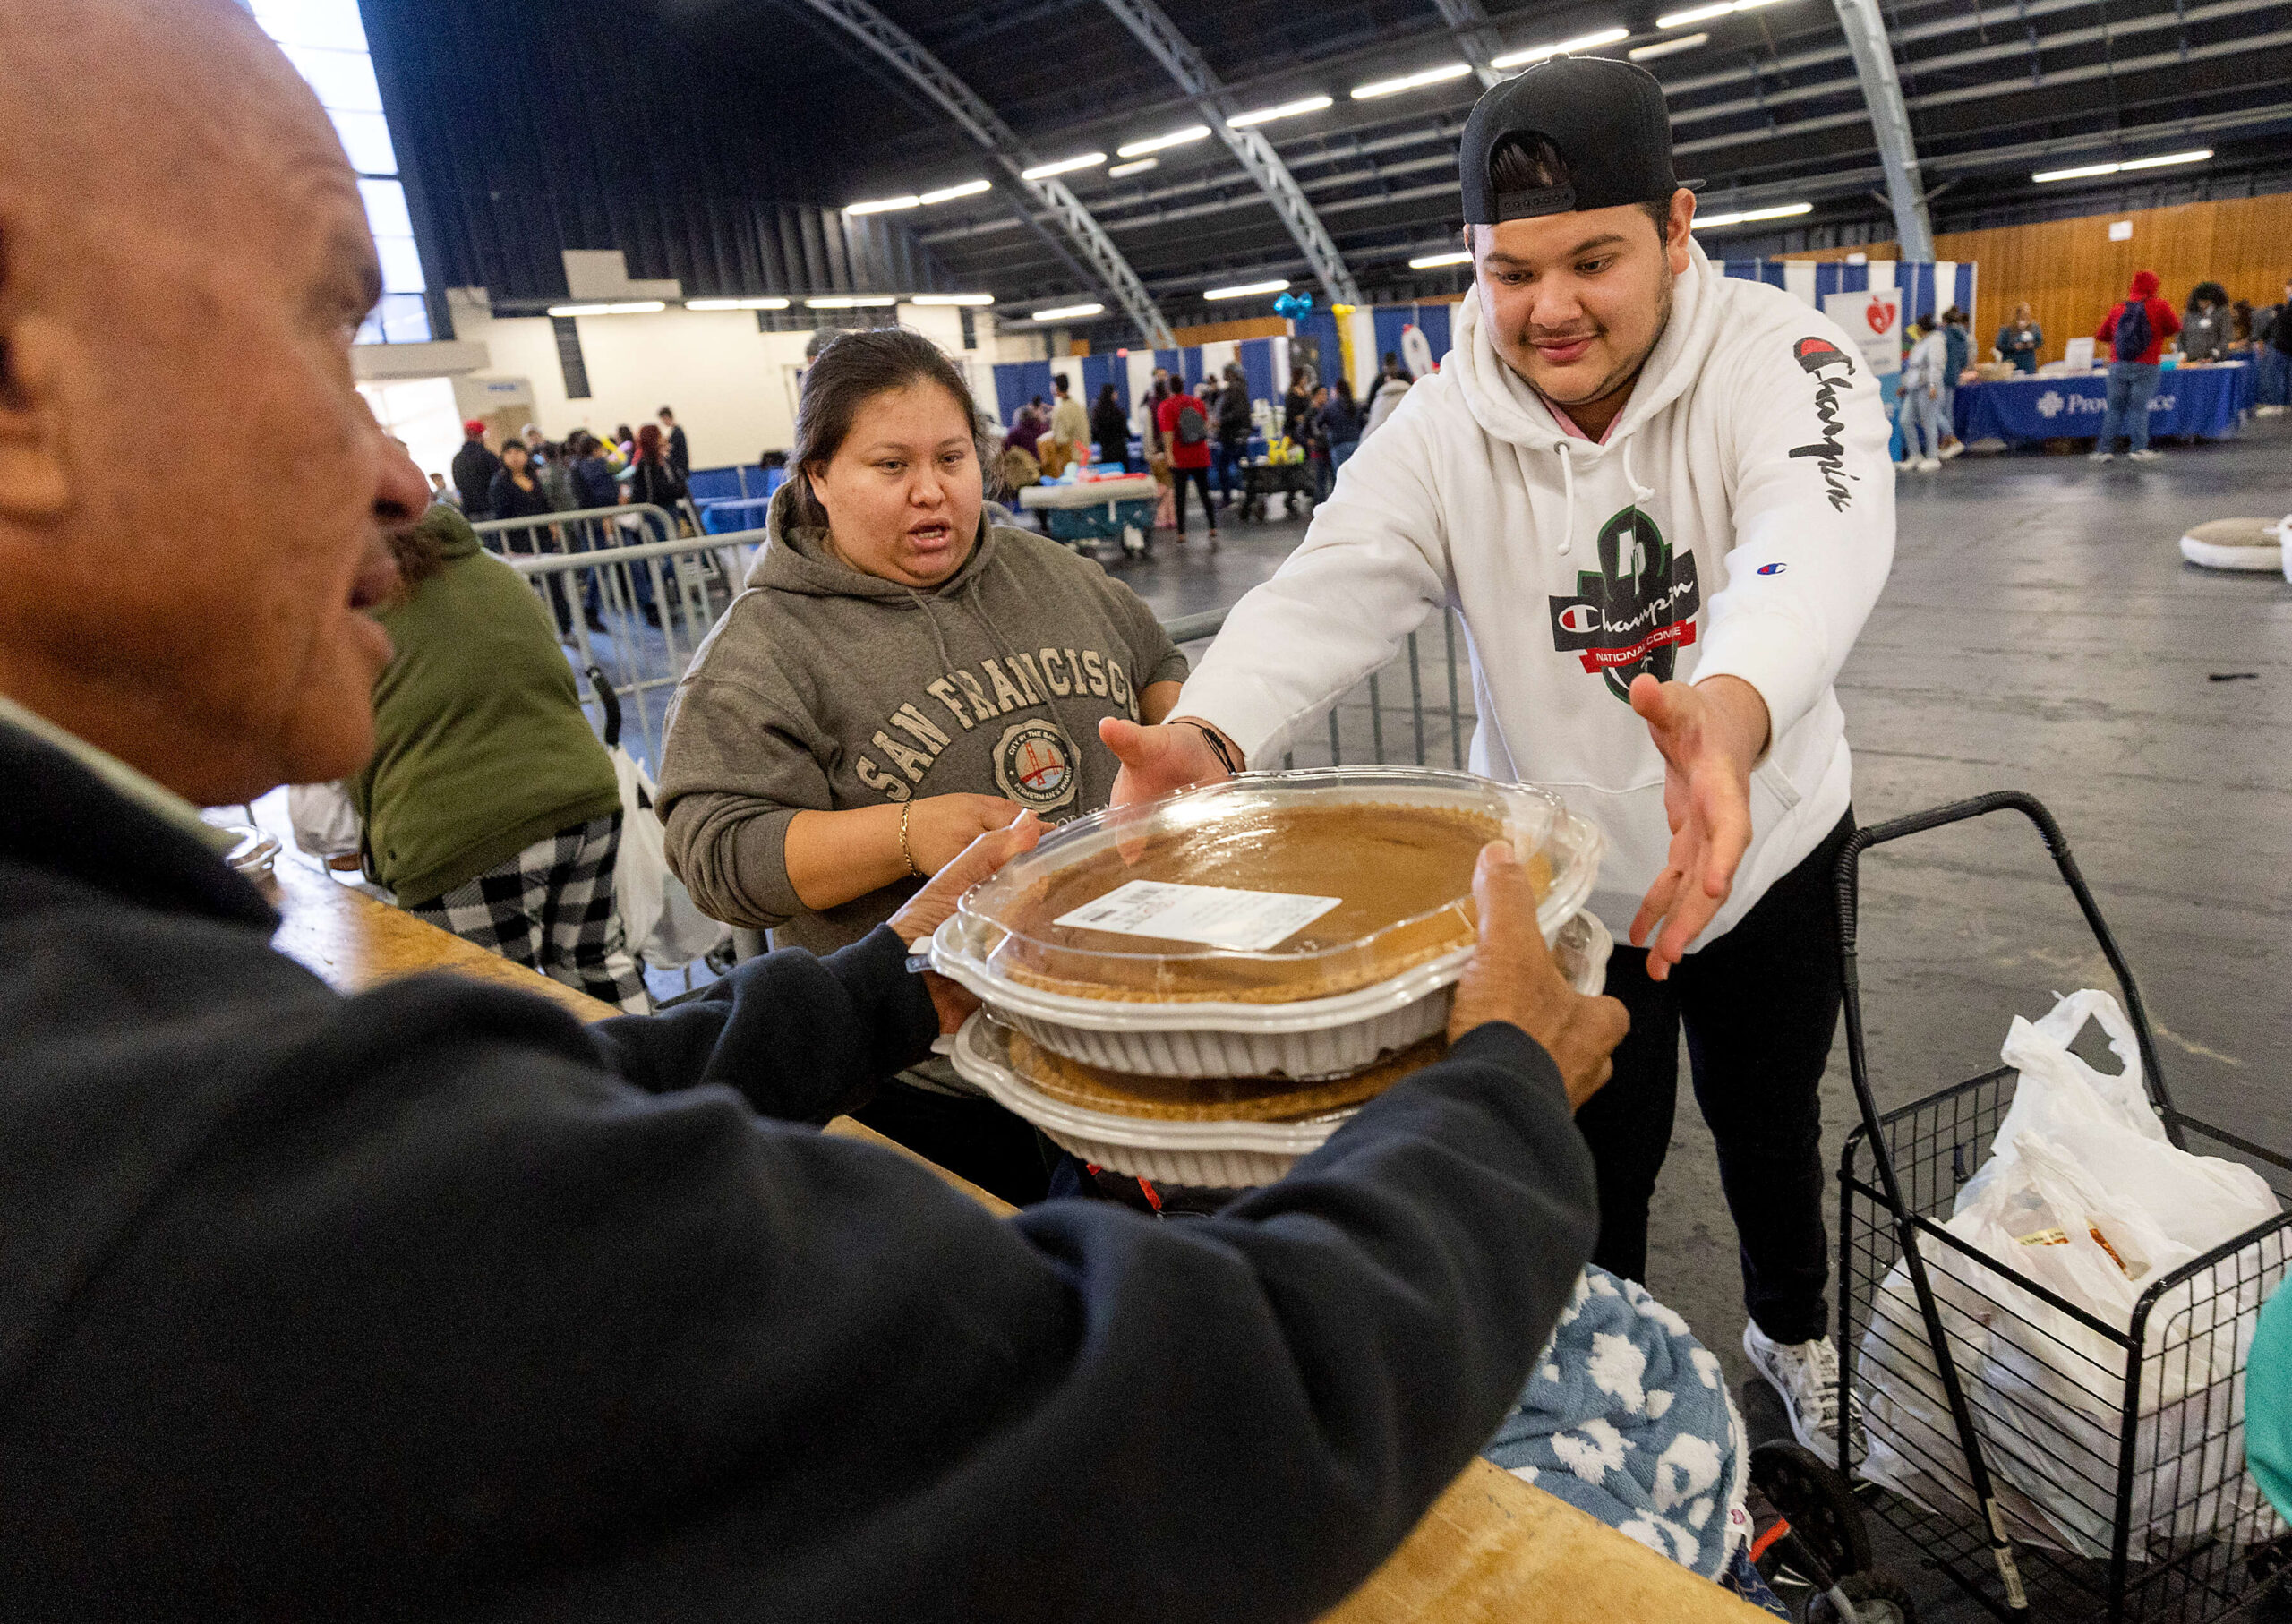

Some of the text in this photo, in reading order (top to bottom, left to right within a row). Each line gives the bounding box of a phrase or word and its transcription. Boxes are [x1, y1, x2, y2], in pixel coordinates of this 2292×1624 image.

[1558, 580, 1694, 633] Champin
[855, 701, 952, 802] SAN
[1008, 739, 1020, 756] CITY
[1019, 733, 1027, 742] BY
[1042, 731, 1057, 742] BAY
[1014, 782, 1061, 799] FISHERMAN'S
